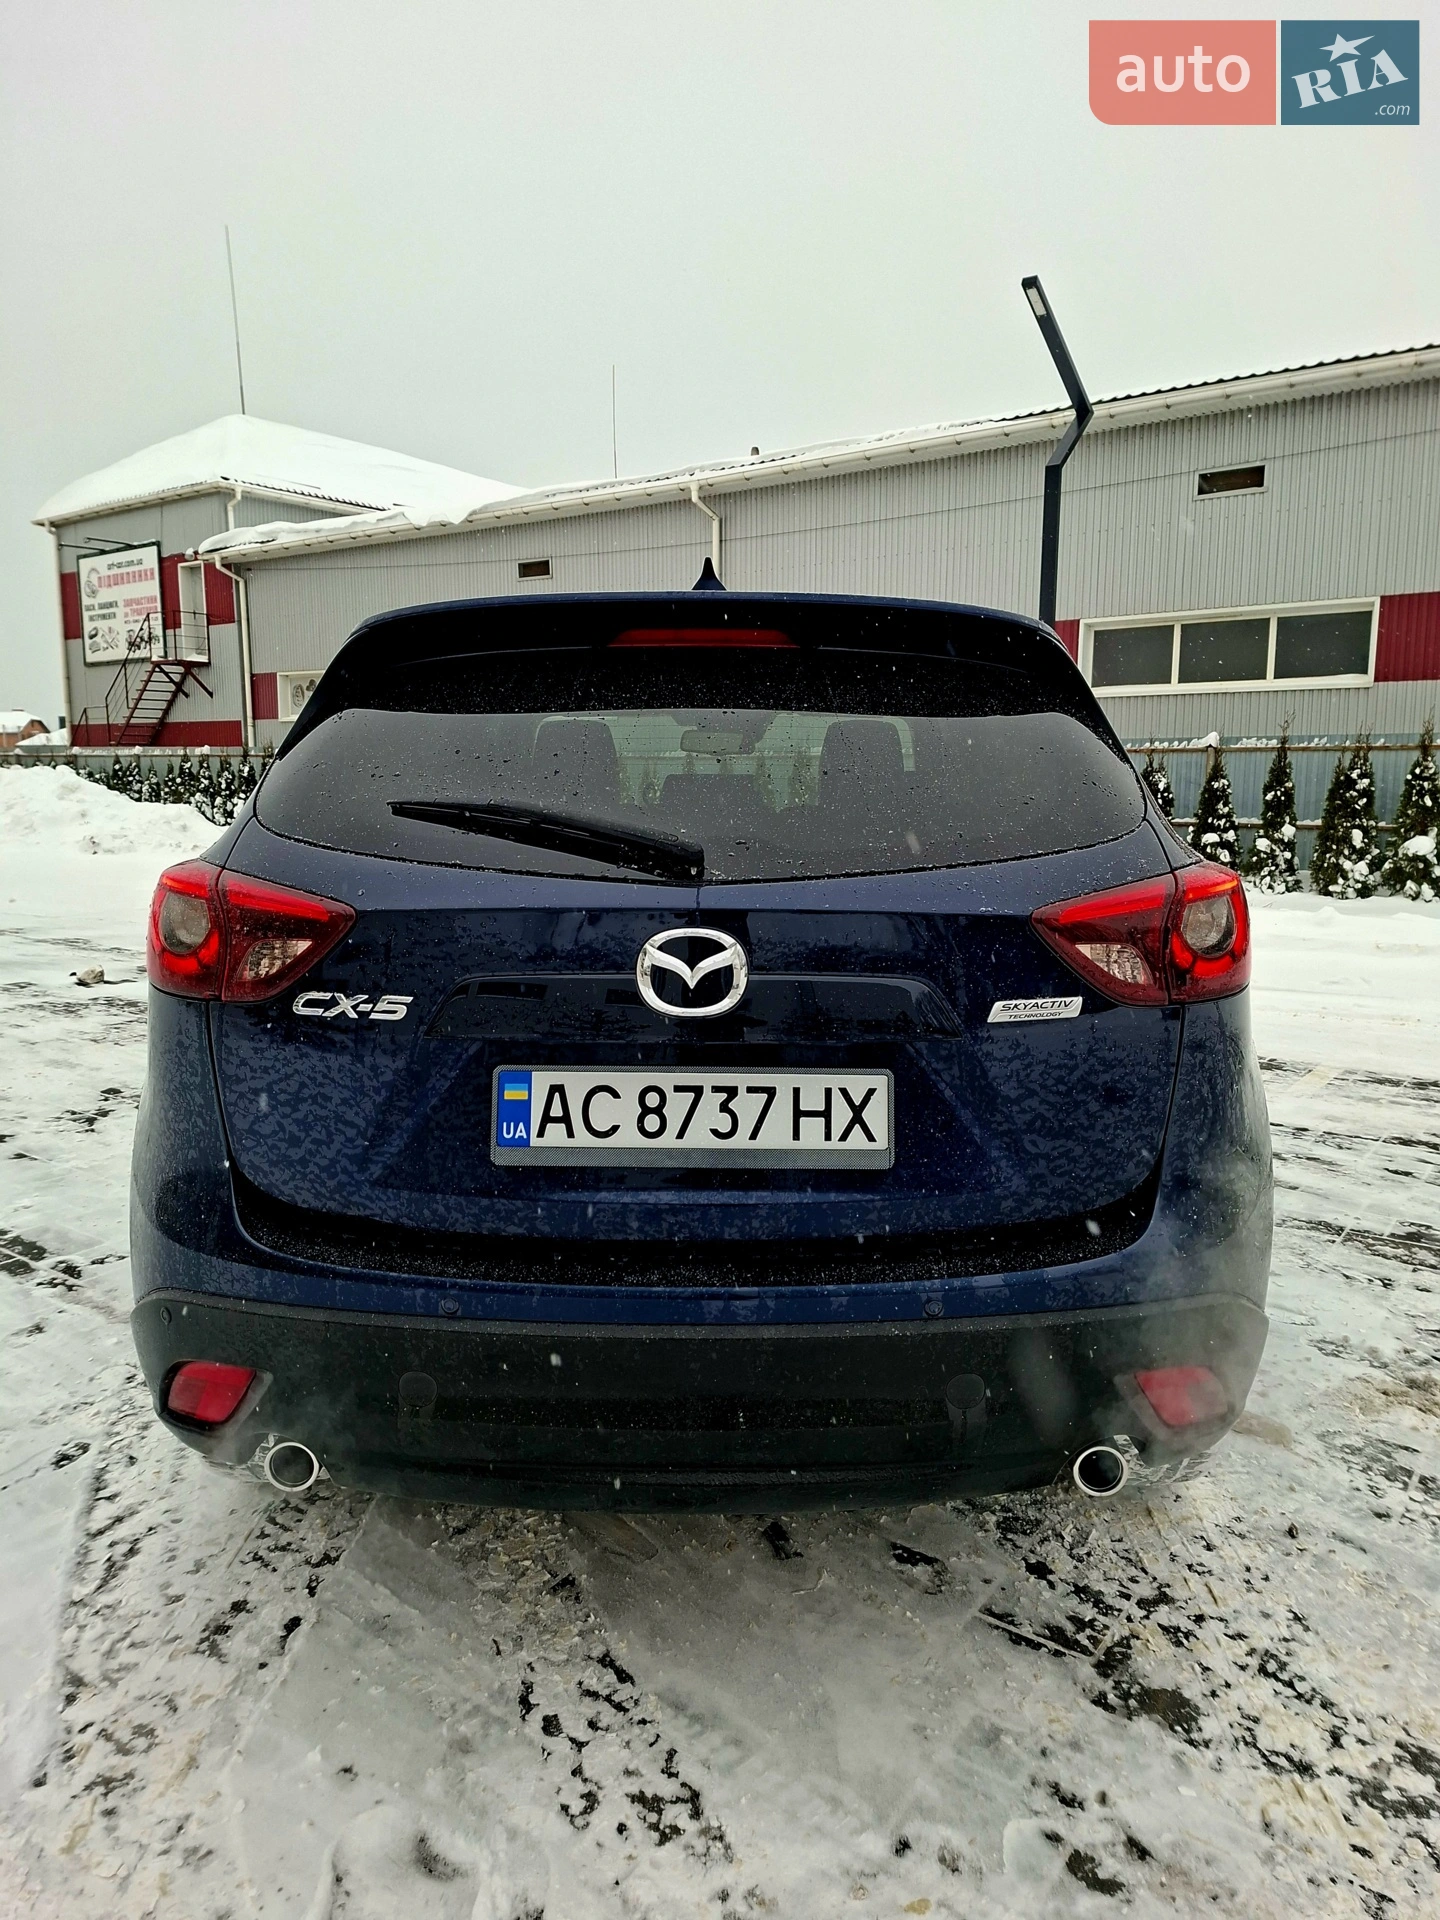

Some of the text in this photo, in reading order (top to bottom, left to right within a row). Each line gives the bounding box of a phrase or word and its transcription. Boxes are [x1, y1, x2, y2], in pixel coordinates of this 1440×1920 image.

[292, 990, 414, 1021] CX-5
[1000, 999, 1074, 1012] SKYACTIV
[1008, 1011, 1063, 1020] TECHNOLOGY
[536, 1083, 878, 1143] AC 8737 HX
[502, 1121, 527, 1140] UA
